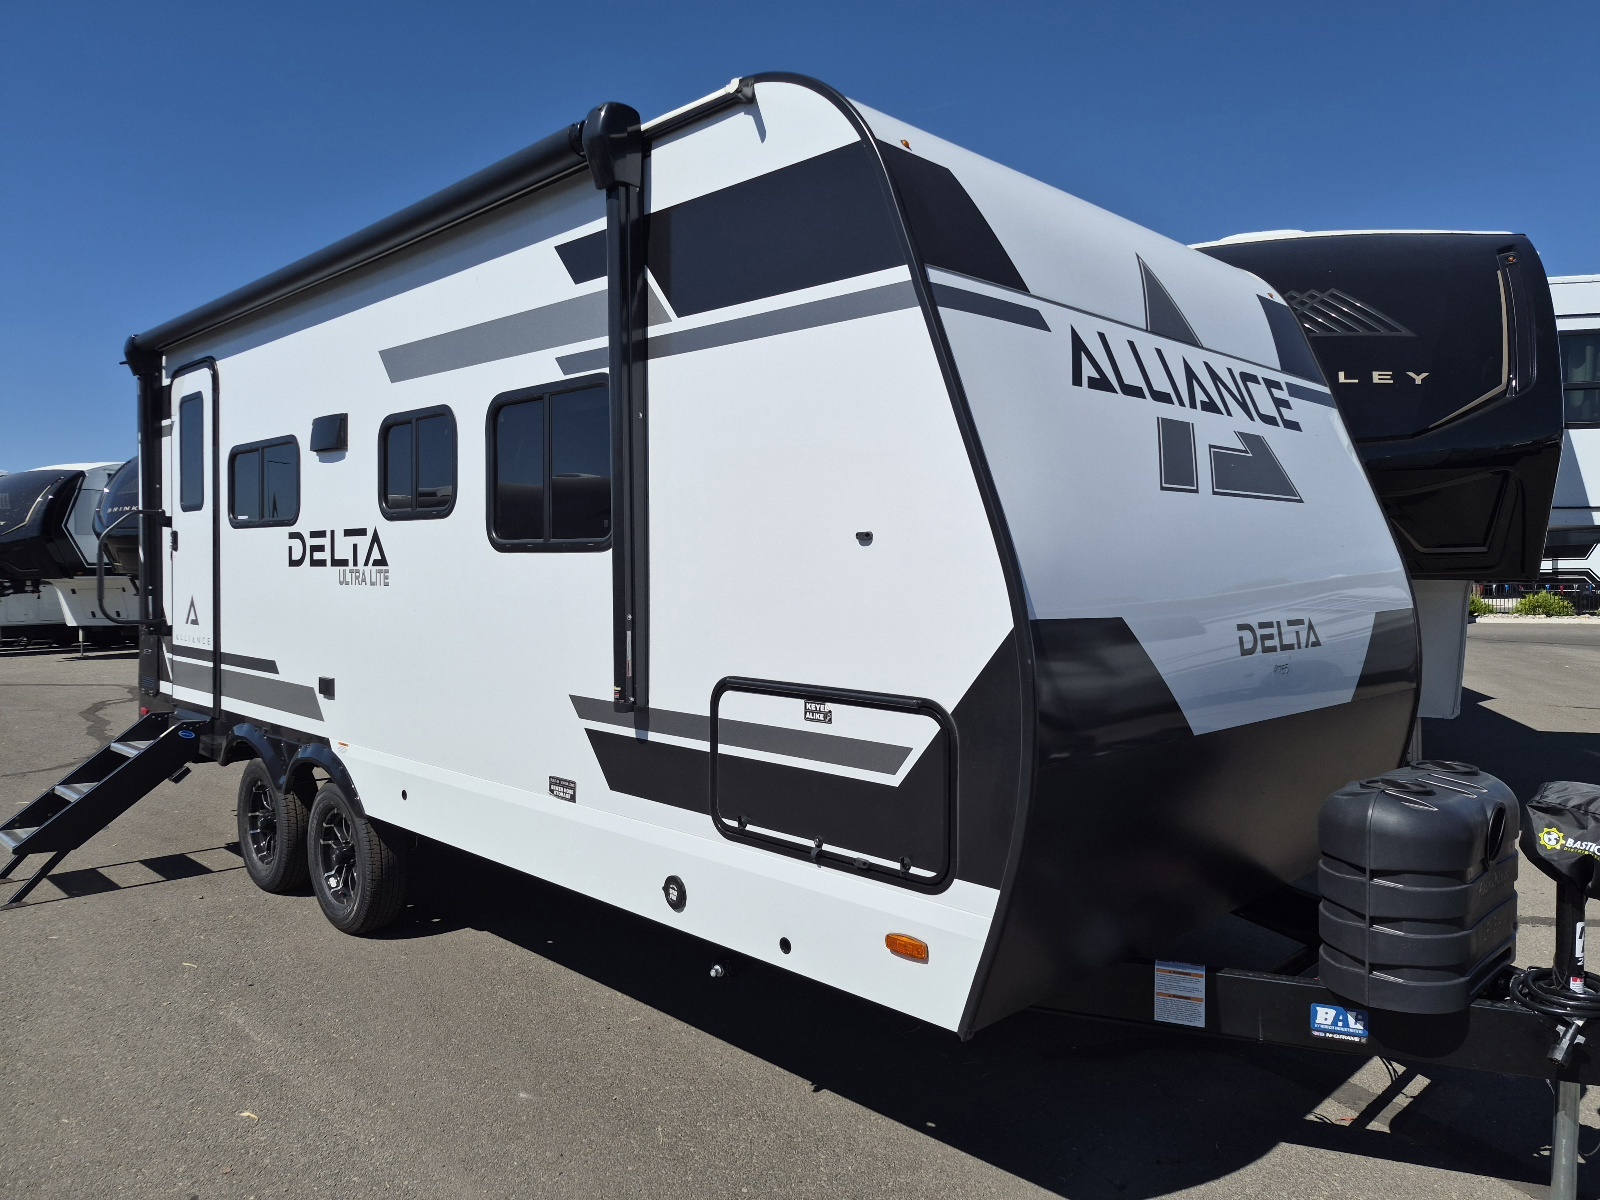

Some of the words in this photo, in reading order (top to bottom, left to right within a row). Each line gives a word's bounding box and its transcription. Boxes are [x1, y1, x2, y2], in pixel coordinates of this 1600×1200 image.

[1070, 324, 1303, 432] ALLIANCE
[288, 526, 389, 567] DELTA
[338, 569, 367, 586] ULTRA
[369, 569, 390, 586] LITE
[1236, 617, 1322, 656] DELTA
[805, 712, 825, 720] ALIKE
[1315, 1007, 1364, 1030] BAL
